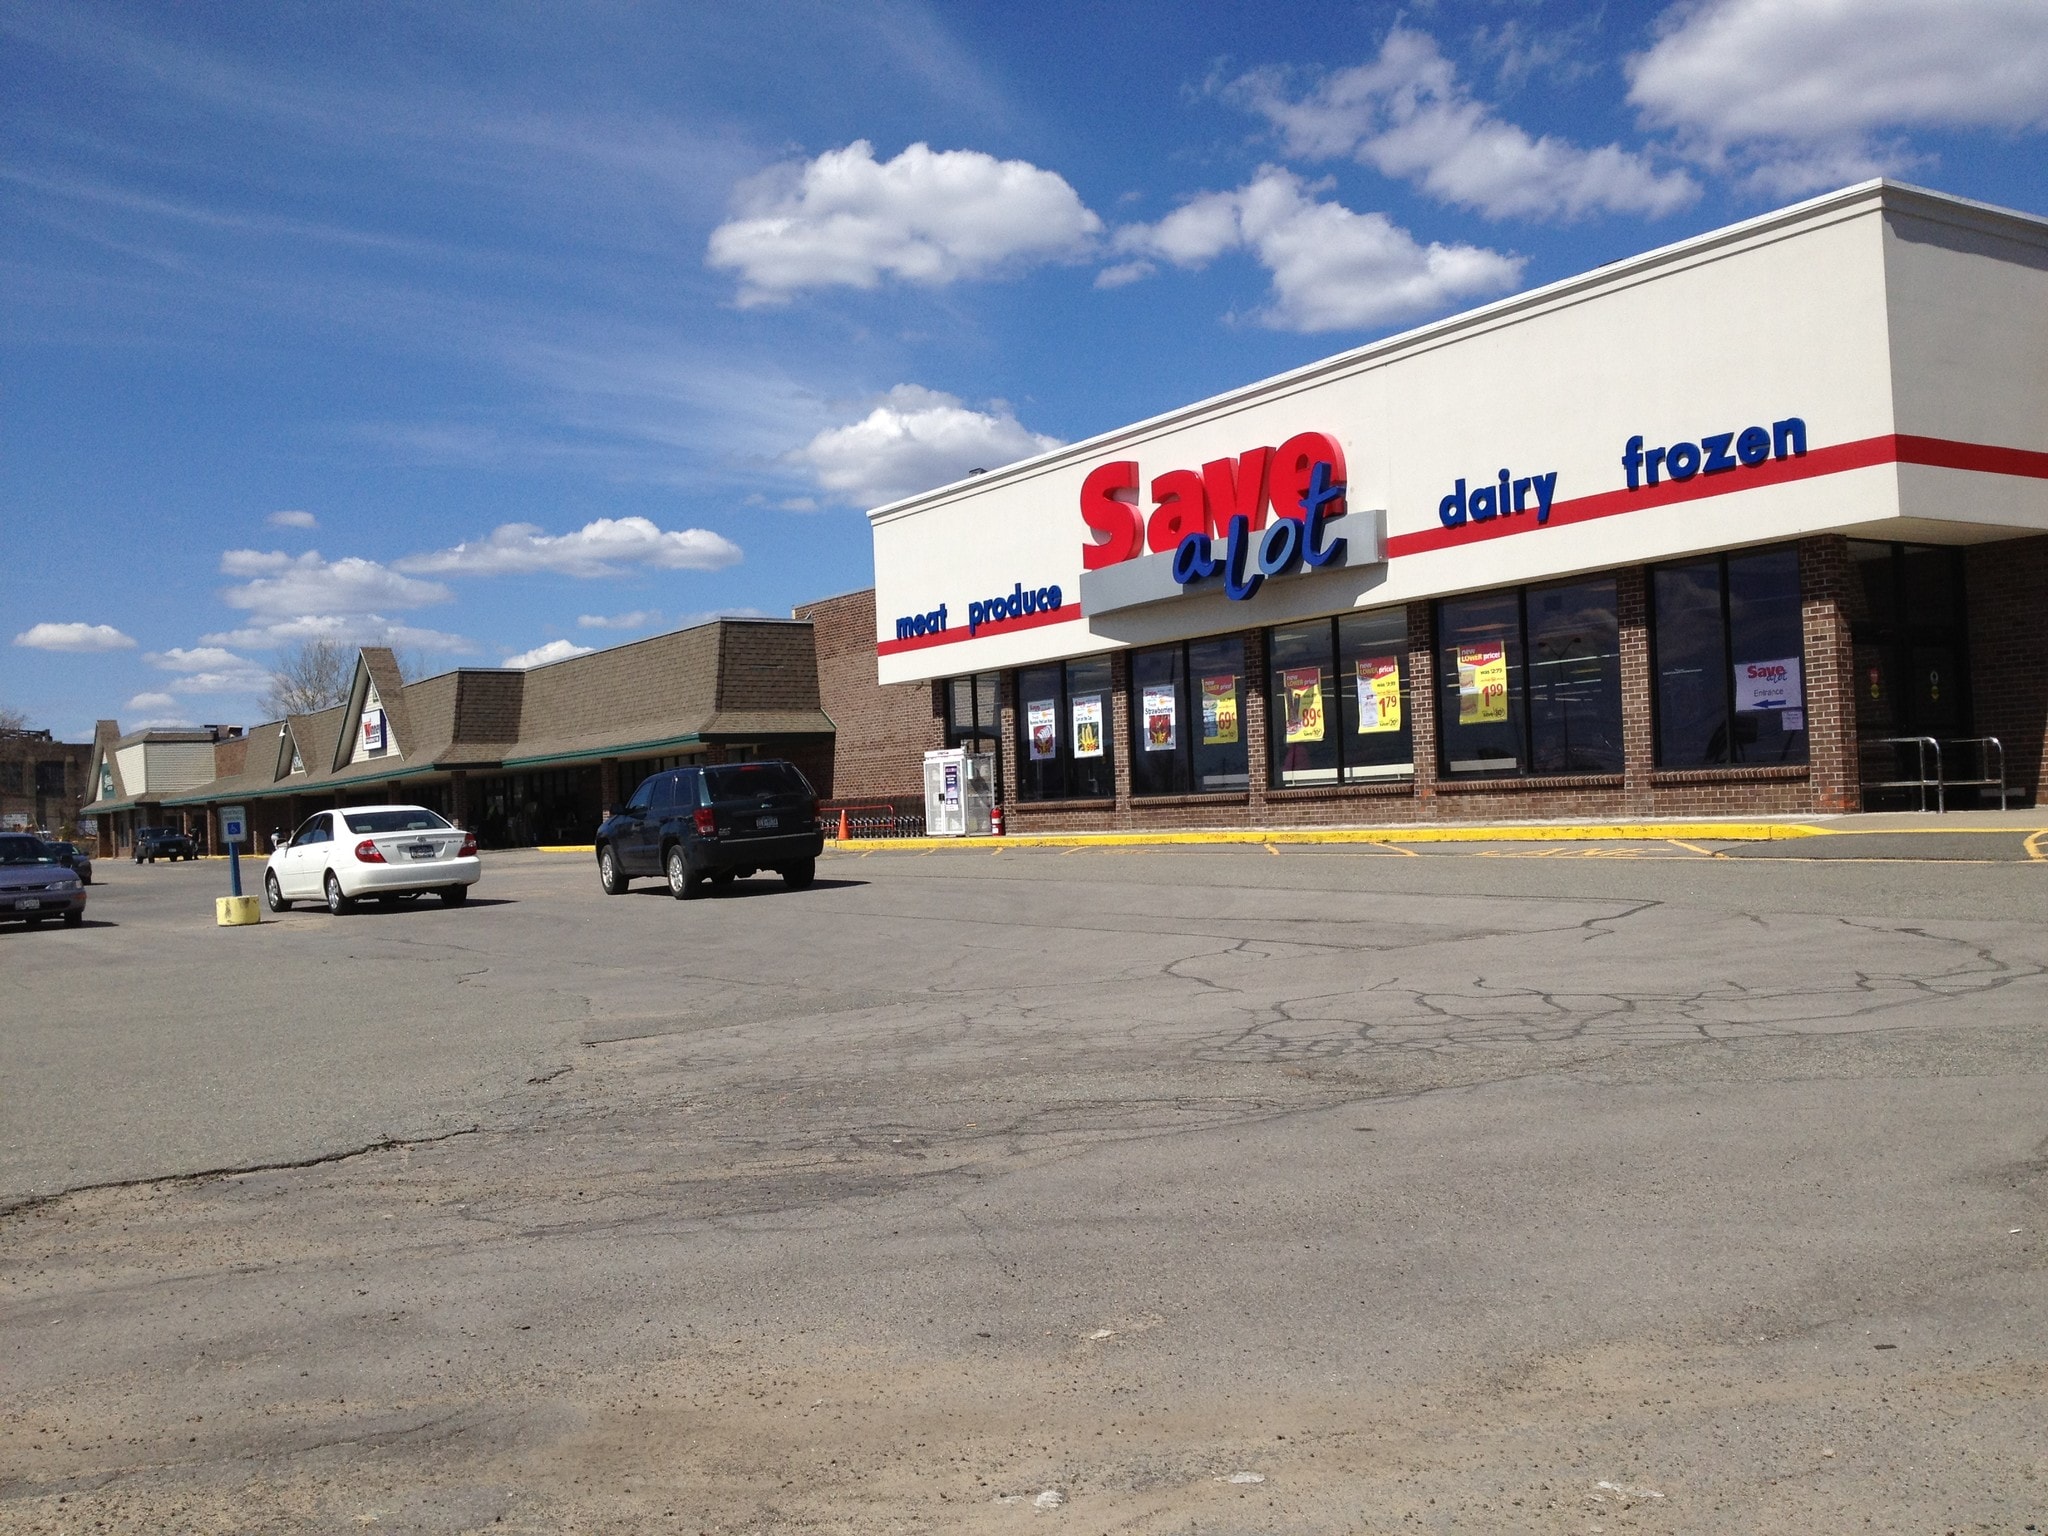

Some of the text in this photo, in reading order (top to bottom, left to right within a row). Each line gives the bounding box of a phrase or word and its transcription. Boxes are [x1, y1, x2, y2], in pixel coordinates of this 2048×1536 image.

[1621, 417, 1808, 491] frozen
[1080, 431, 1348, 570] Save
[1438, 468, 1558, 528] dairy
[896, 603, 948, 641] meat
[968, 583, 1062, 637] produce
[1747, 665, 1786, 679] Save
[1753, 689, 1784, 697] Entrance
[1145, 707, 1173, 715] Strawberries
